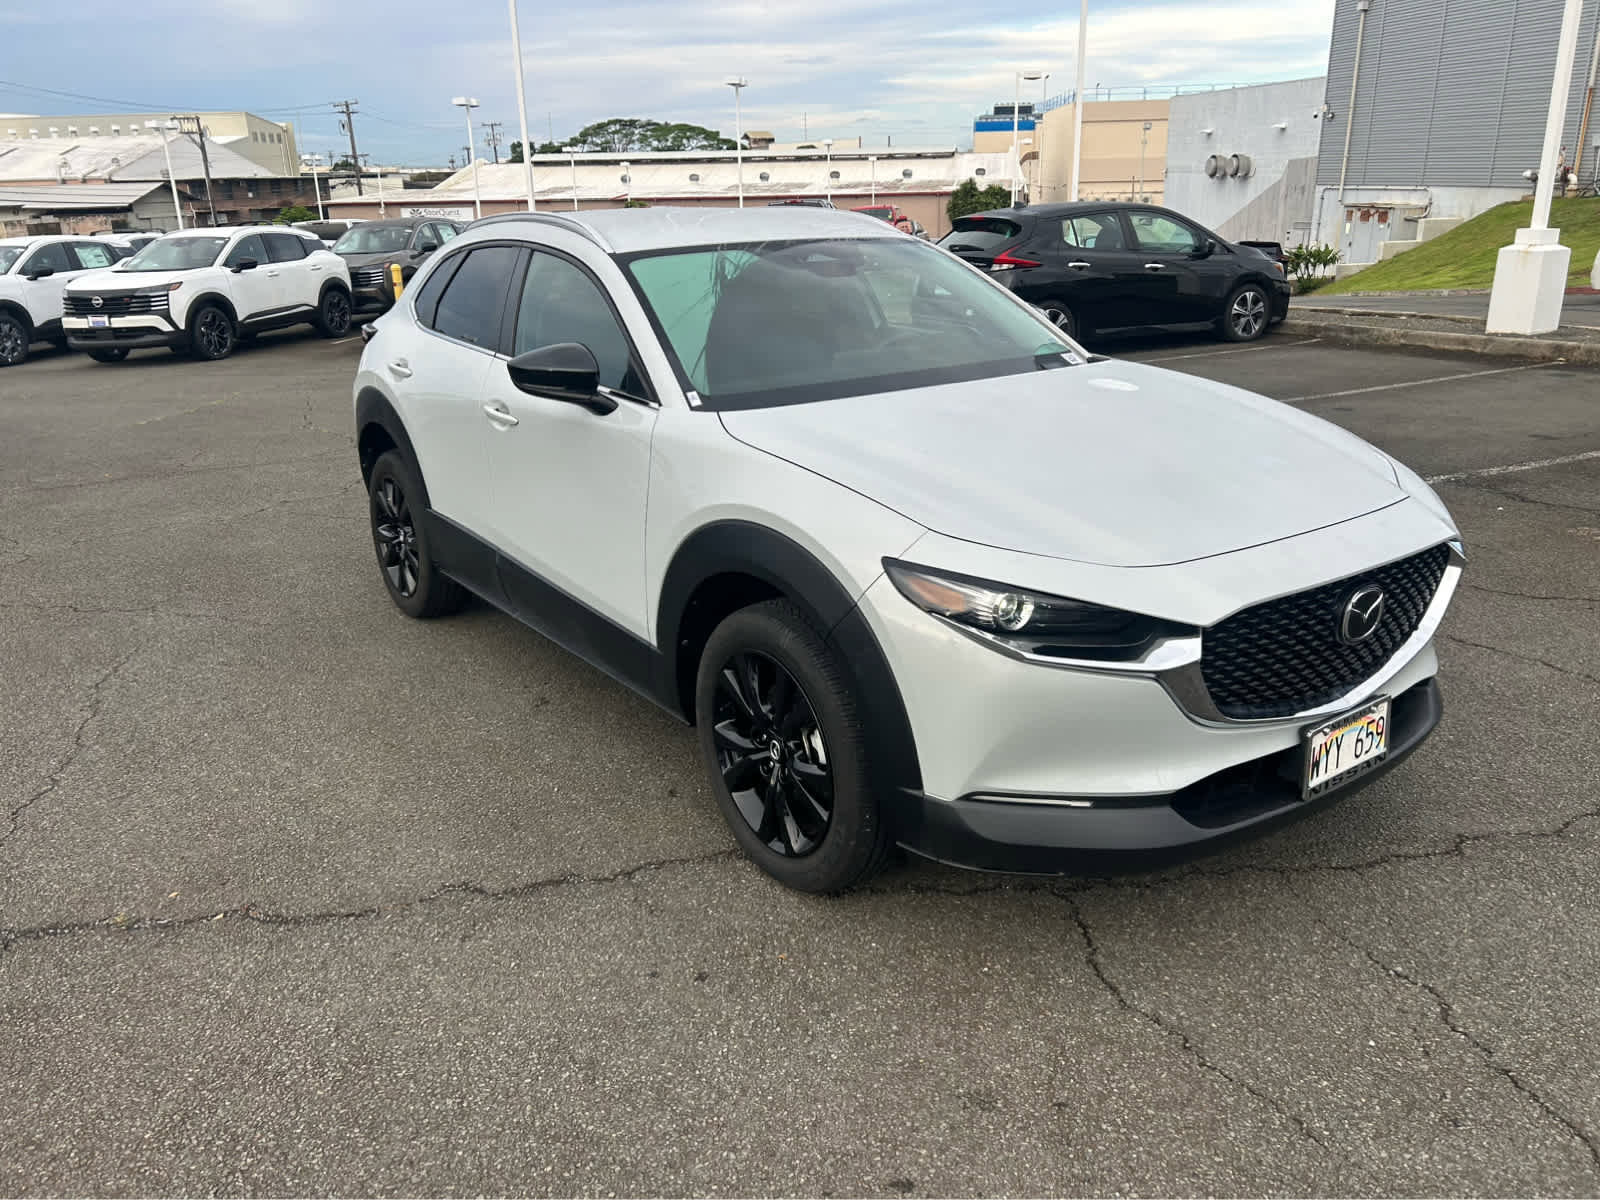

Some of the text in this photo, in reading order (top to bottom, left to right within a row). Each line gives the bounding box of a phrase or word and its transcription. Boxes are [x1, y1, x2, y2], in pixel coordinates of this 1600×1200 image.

[1308, 752, 1386, 797] NISSAN
[1310, 733, 1344, 781] WYY
[1354, 716, 1385, 759] 659
